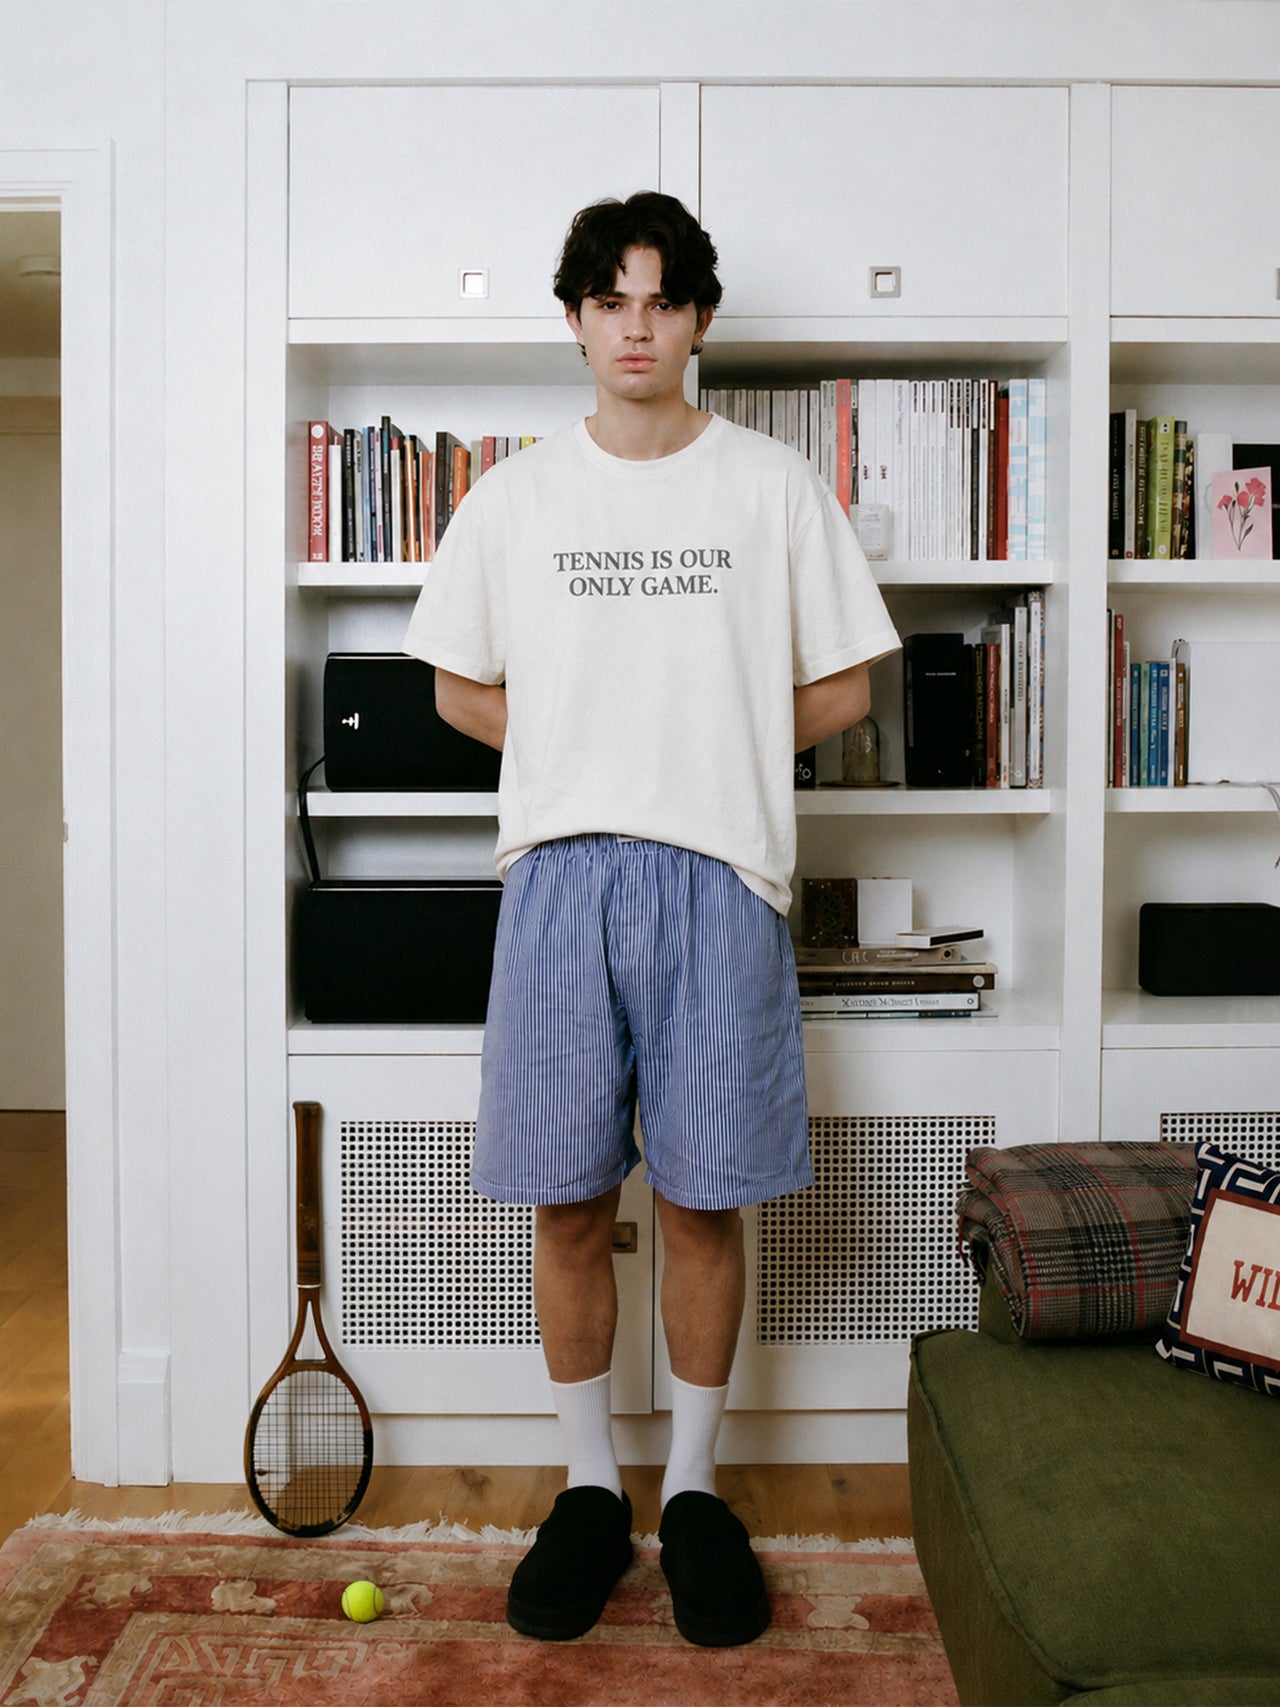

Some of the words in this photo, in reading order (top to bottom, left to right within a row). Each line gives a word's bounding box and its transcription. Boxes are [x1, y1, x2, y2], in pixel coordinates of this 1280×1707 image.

[554, 552, 643, 571] TENNIS
[652, 551, 672, 569] IS
[680, 550, 732, 568] OUR
[570, 578, 634, 596] ONLY
[641, 575, 717, 596] GAME.
